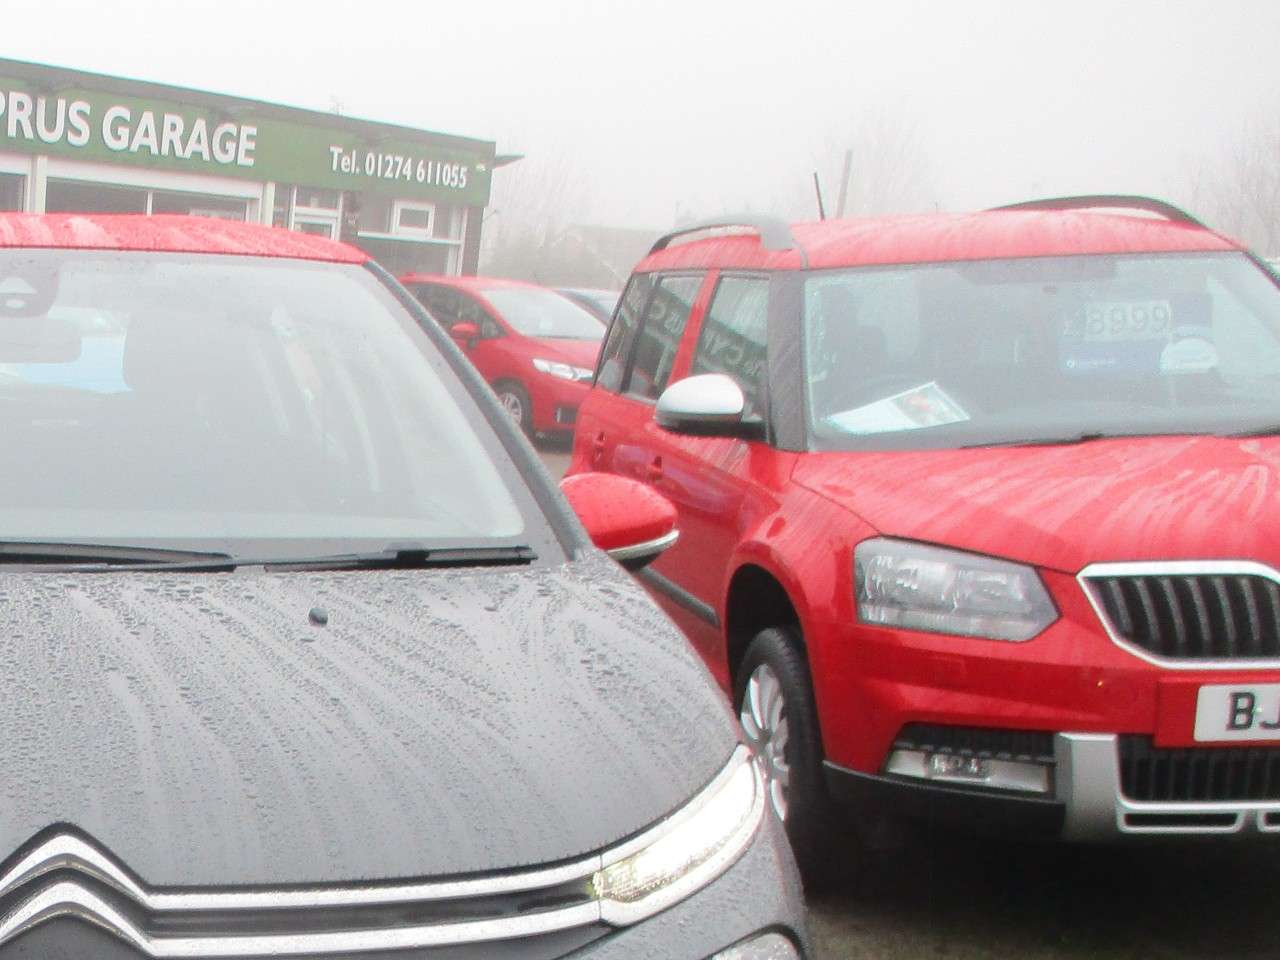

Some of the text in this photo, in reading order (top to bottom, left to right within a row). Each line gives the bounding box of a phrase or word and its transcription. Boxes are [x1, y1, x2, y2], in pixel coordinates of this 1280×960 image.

[102, 105, 258, 167] GARAGE
[329, 146, 468, 188] Tel. 01274 611055
